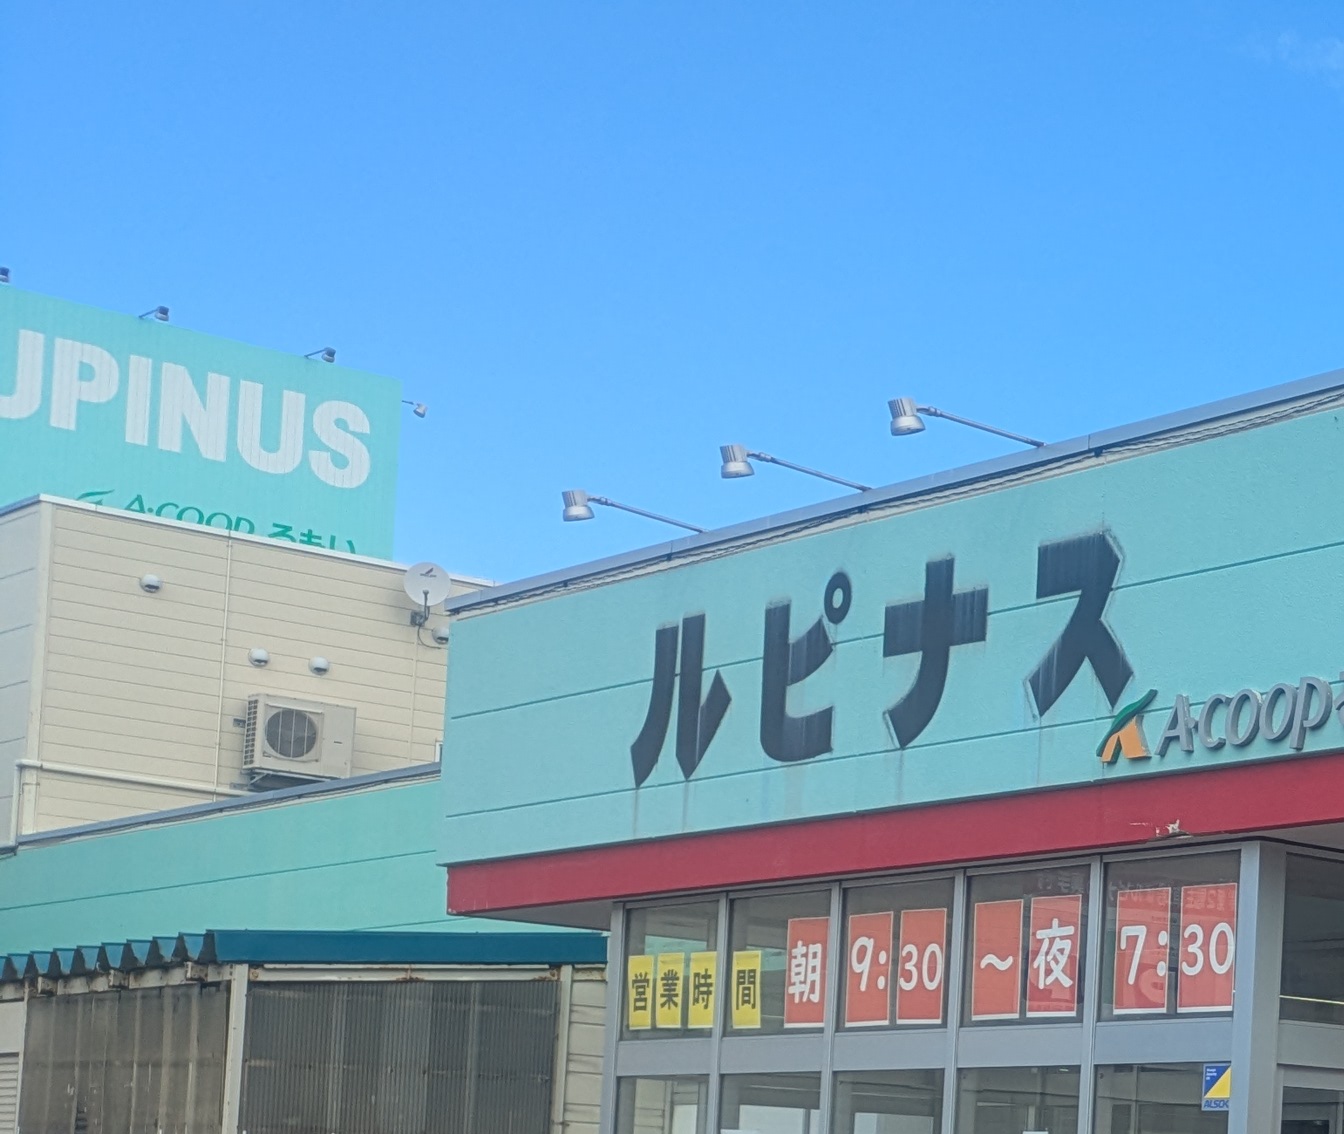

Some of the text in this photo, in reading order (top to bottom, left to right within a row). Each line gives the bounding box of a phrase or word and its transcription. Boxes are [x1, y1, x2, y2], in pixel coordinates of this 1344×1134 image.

[631, 529, 1134, 788] ルピナス
[631, 968, 757, 1012] 営業時間
[788, 940, 822, 1004] 朝
[851, 936, 943, 992] 9:30
[1033, 918, 1075, 989] 夜
[1120, 922, 1235, 985] 7:30
